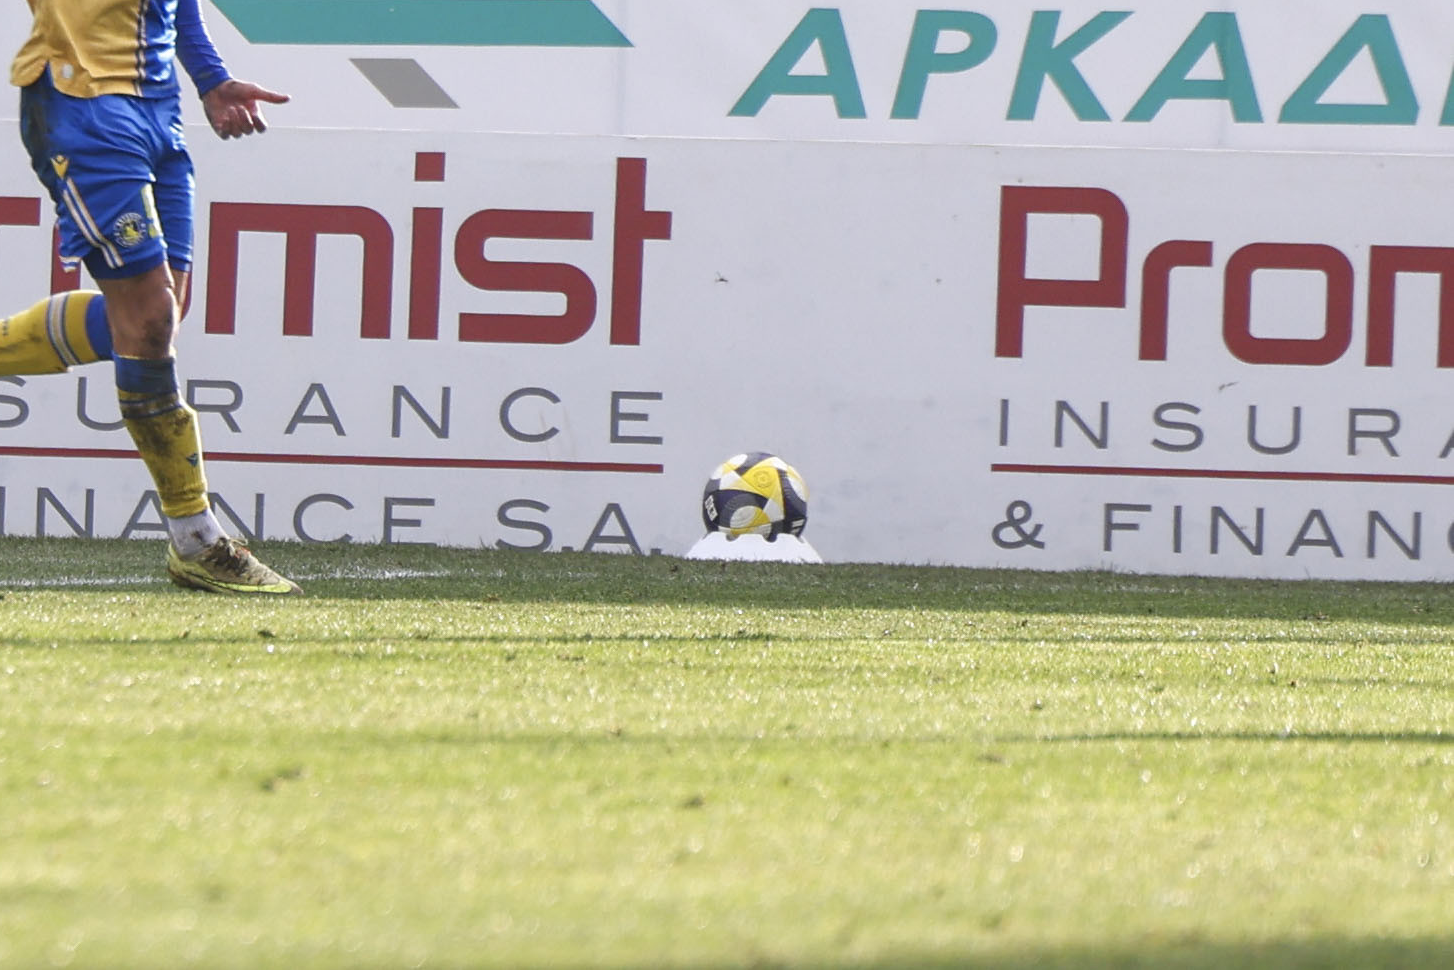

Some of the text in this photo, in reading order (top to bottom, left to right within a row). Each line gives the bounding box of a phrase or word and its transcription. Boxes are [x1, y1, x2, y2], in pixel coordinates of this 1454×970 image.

[727, 7, 1454, 126] ΑΡΚΑΔ
[999, 398, 1454, 459] INSUR
[991, 500, 1454, 561] & FINAN
